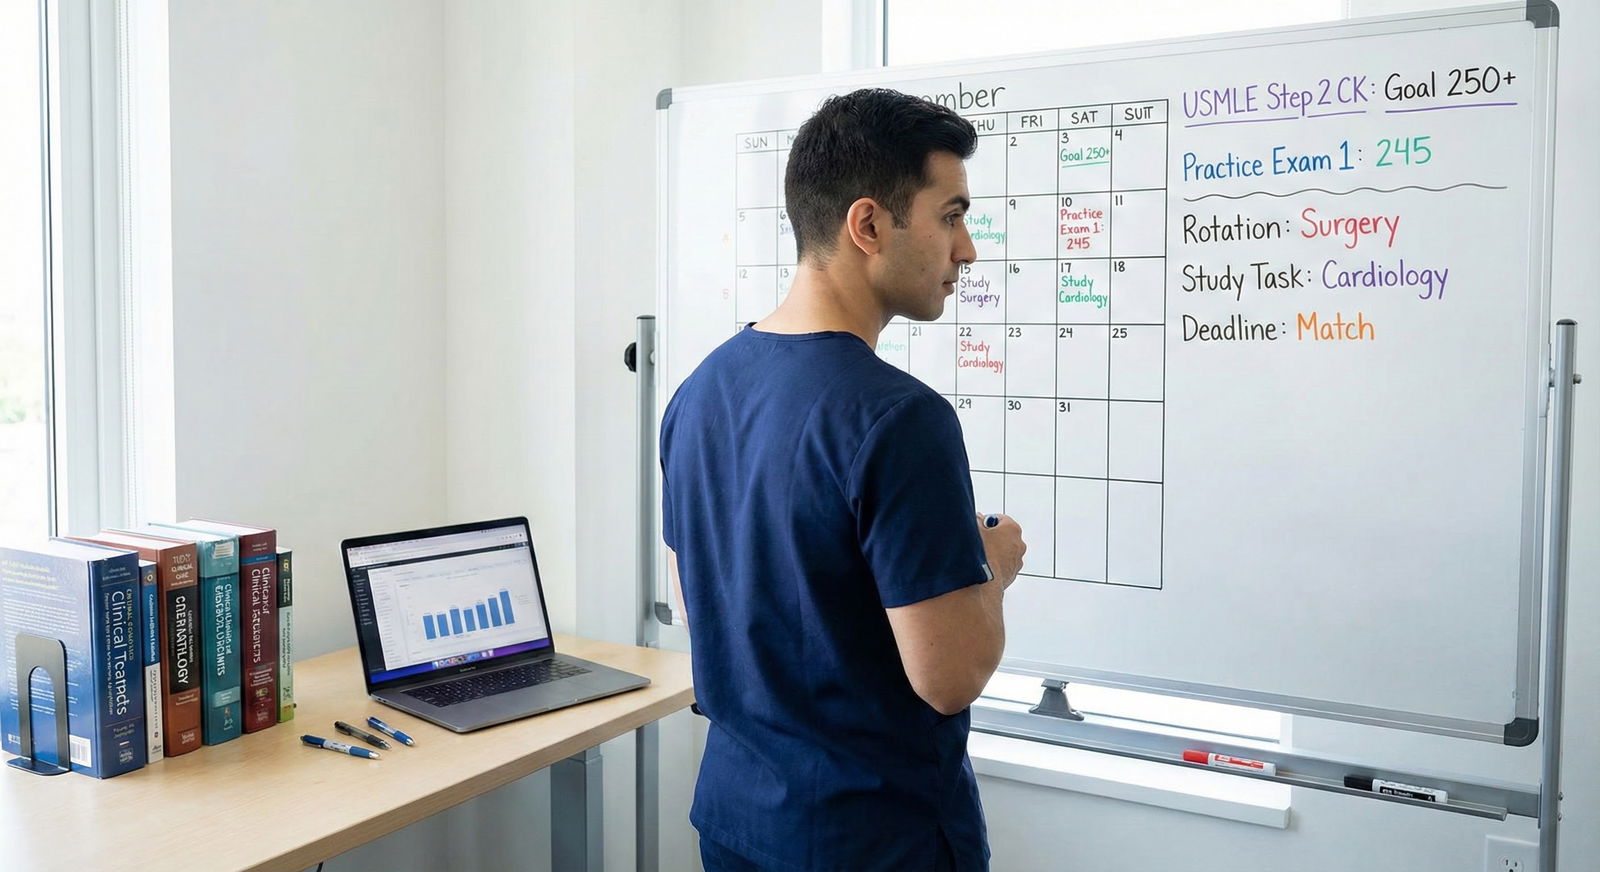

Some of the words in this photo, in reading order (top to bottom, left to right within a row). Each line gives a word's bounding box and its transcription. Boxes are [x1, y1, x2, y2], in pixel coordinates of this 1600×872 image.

[1183, 85, 1258, 118] USMLE
[1267, 83, 1313, 116] Step
[1317, 79, 1332, 105] 2
[1337, 76, 1376, 103] CK:
[1384, 71, 1436, 101] Goal
[1447, 66, 1516, 97] 250+
[1021, 115, 1043, 128] FRI
[1071, 110, 1098, 125] SAT
[1061, 132, 1069, 144] 3
[1115, 129, 1123, 141] 4
[744, 136, 768, 149] SUN
[1010, 136, 1018, 147] 2
[1060, 148, 1083, 162] Goal
[1086, 147, 1110, 160] 250+
[1183, 152, 1264, 182] Practice
[1273, 146, 1331, 175] Exam
[1338, 140, 1363, 171] 1:
[1376, 136, 1432, 167] 245
[1009, 199, 1016, 210] 9
[1061, 197, 1072, 207] 10
[1115, 195, 1123, 206] 11
[739, 212, 746, 222] 5
[780, 210, 787, 220] 6
[1060, 208, 1103, 221] Practice
[1060, 224, 1090, 235] Exam
[1183, 213, 1291, 244] Rotation:
[1300, 207, 1400, 249] Surgery
[971, 230, 1006, 244] rdiology
[1066, 238, 1091, 250] 245
[960, 265, 971, 275] 15
[1009, 264, 1020, 274] 16
[1060, 262, 1071, 273] 17
[1114, 261, 1126, 272] 18
[739, 269, 748, 279] 12
[780, 268, 789, 278] 13
[960, 275, 990, 292] Study
[1061, 275, 1094, 293] Study
[1182, 264, 1244, 301] Study
[1250, 262, 1312, 291] Task:
[1321, 259, 1449, 300] Cardiology
[960, 290, 1000, 308] Surgery
[1059, 290, 1108, 309] Cardiology
[912, 326, 922, 336] 21
[959, 327, 972, 337] 22
[1182, 313, 1287, 342] Deadline:
[1297, 311, 1375, 341] Match
[1008, 327, 1022, 338] 23
[1059, 327, 1073, 338] 24
[1112, 328, 1128, 339] 25
[960, 341, 990, 359] Study
[958, 356, 1004, 373] Cardiology
[958, 399, 972, 409] 29
[1008, 400, 1022, 411] 30
[1059, 402, 1071, 413] 31
[111, 591, 128, 648] Clinical
